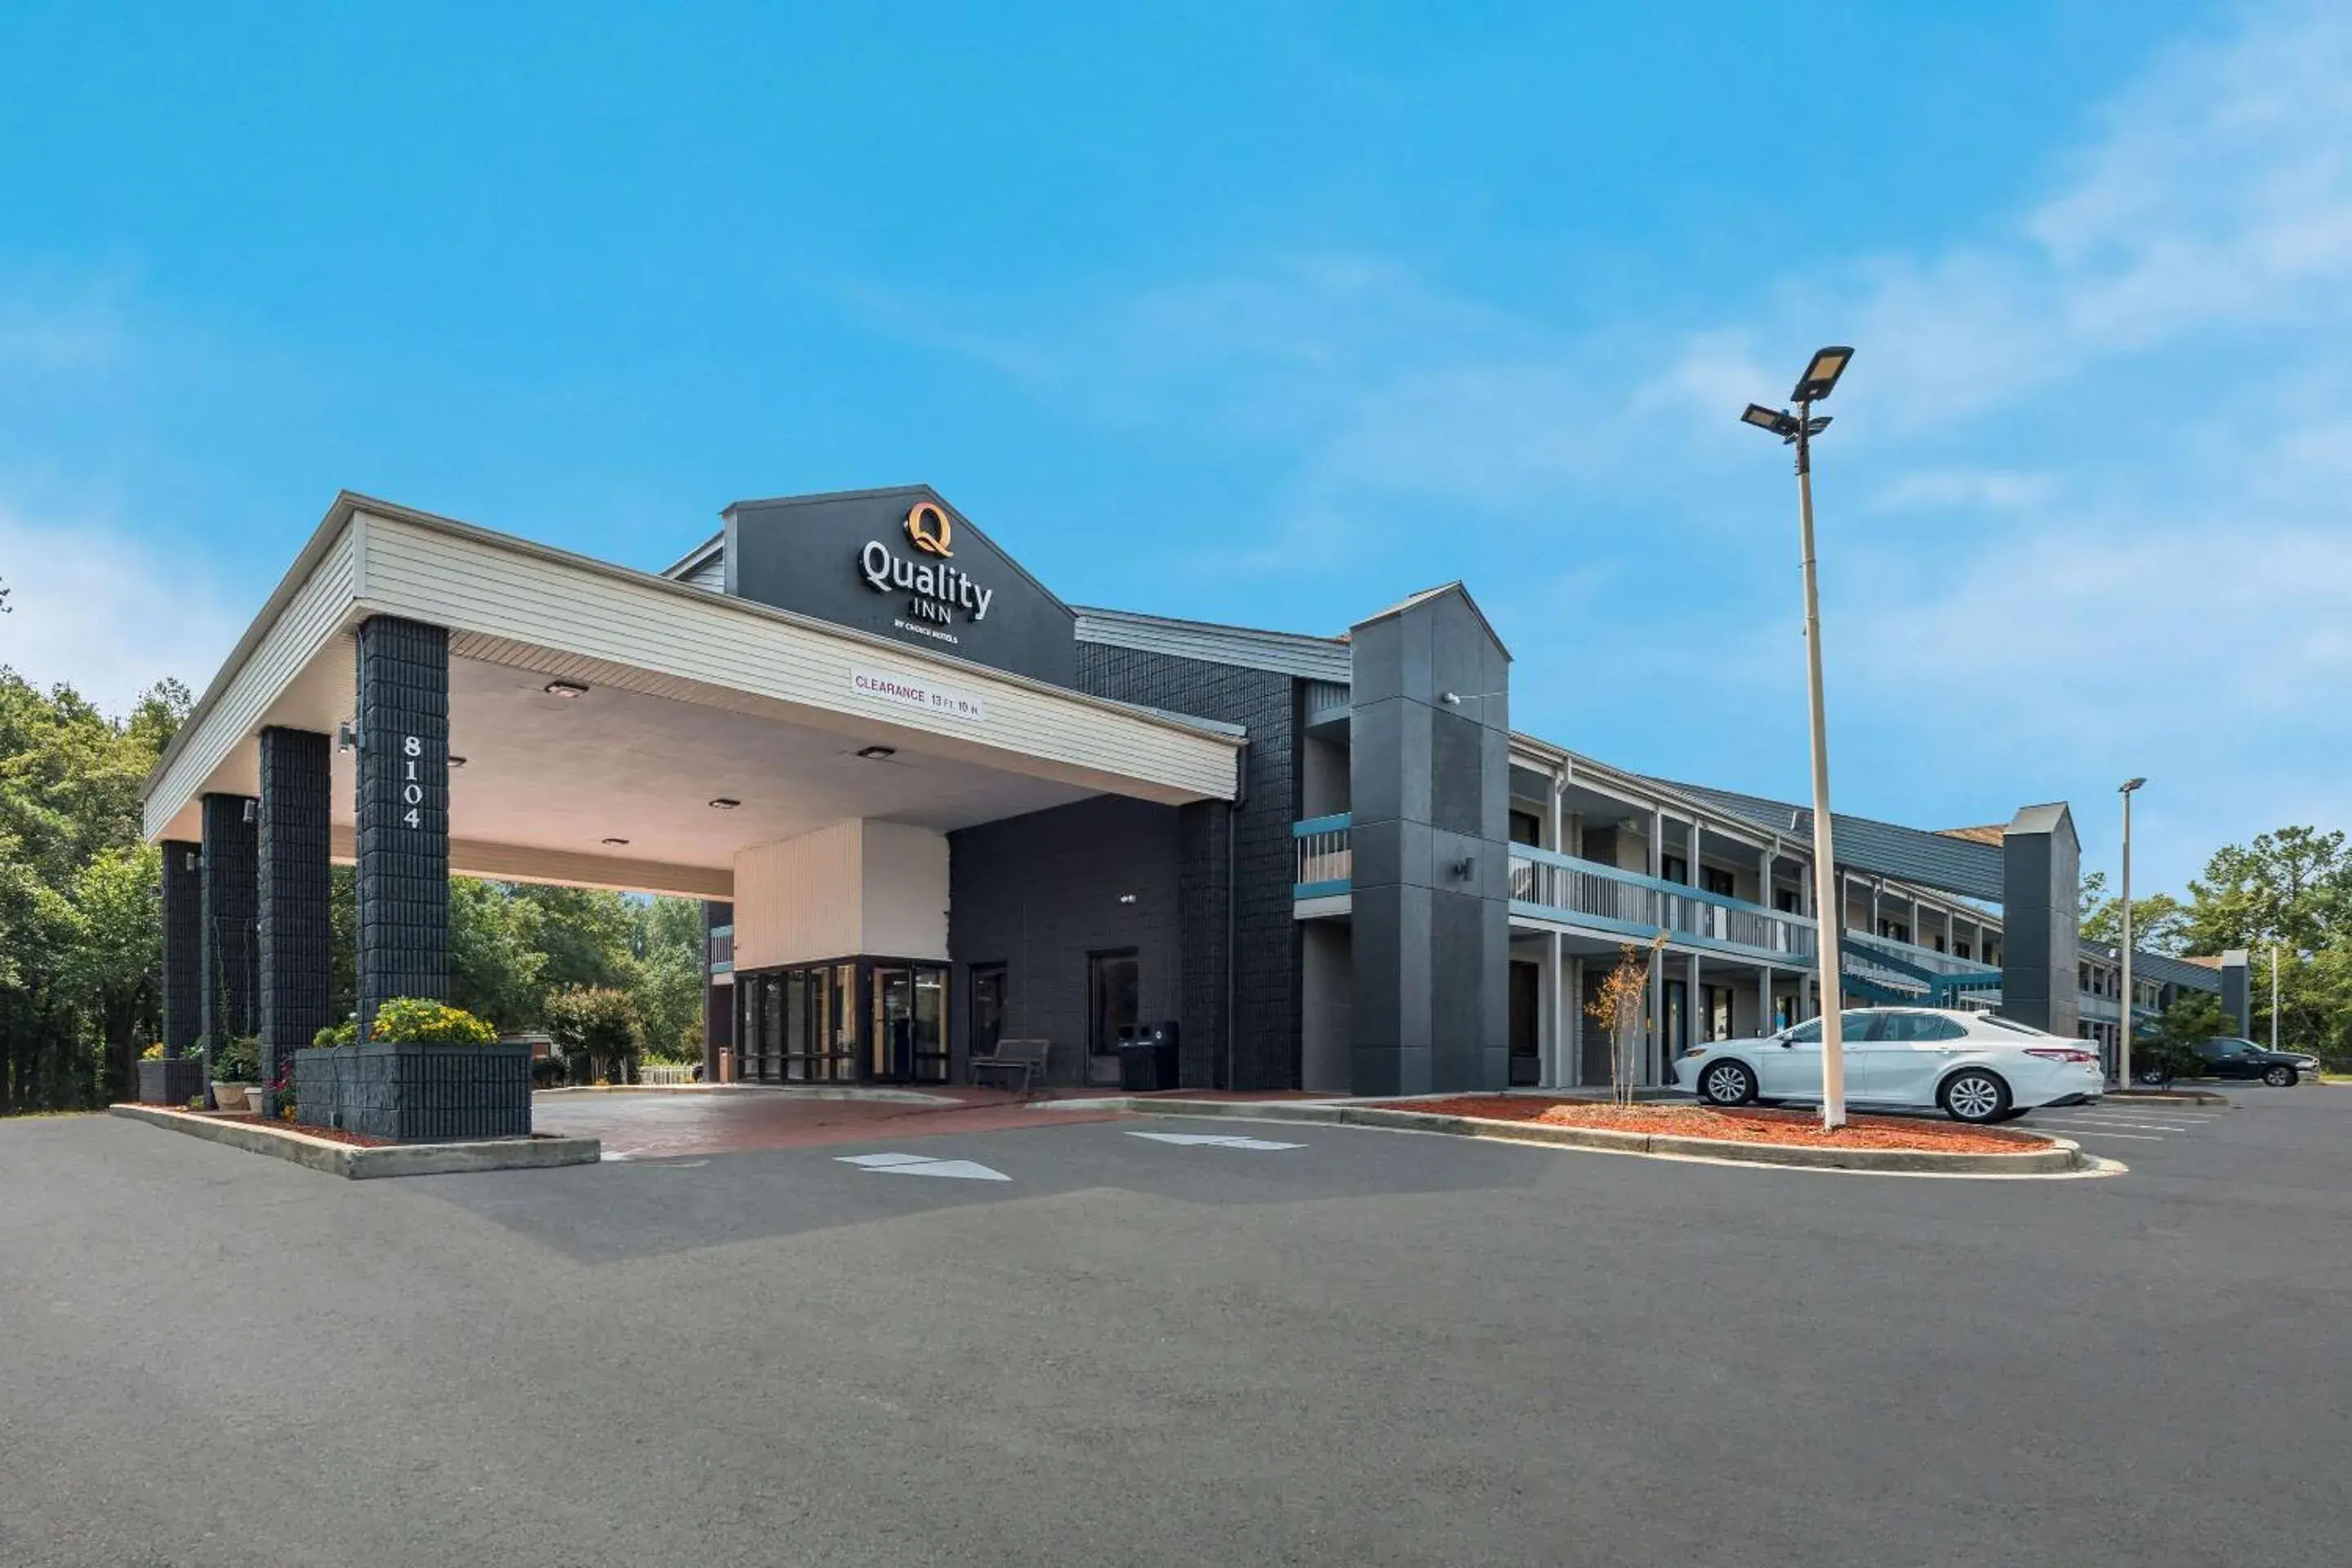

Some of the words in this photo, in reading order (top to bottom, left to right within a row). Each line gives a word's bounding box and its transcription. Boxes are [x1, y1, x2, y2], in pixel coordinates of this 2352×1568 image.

[906, 501, 954, 557] Q
[863, 540, 992, 620] Quality
[914, 597, 951, 624] INN
[856, 675, 925, 702] CLEARANCE
[931, 694, 942, 706] 13
[958, 701, 969, 713] 10
[403, 736, 423, 829] 8104
